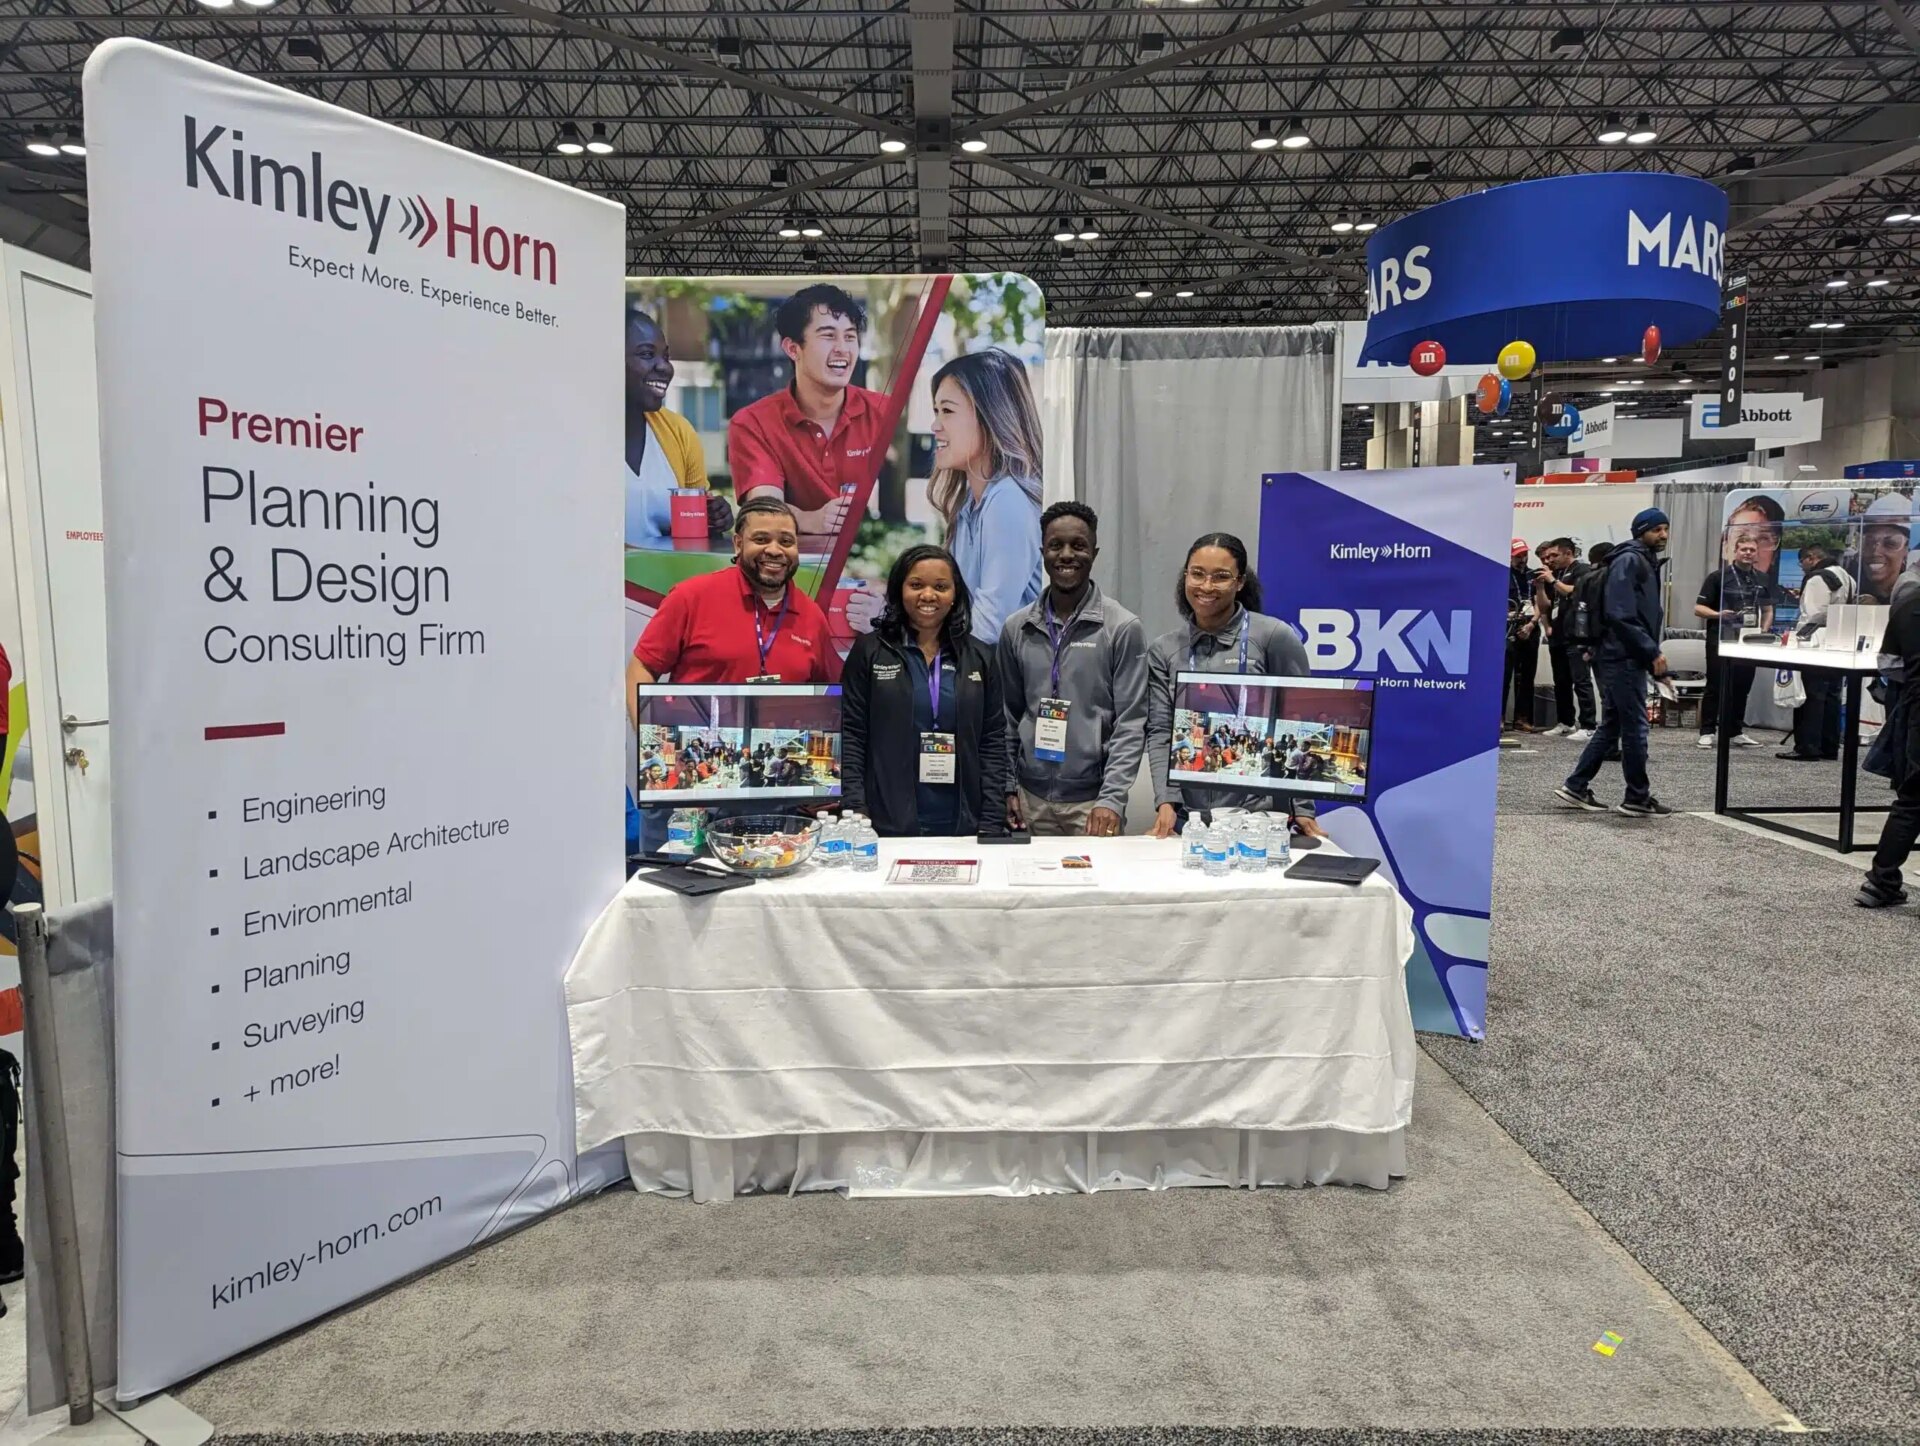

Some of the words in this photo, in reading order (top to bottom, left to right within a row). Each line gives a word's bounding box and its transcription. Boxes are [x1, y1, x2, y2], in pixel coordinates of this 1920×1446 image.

[185, 115, 391, 255] Kimley
[446, 197, 557, 285] Horn
[1627, 209, 1726, 287] MARS
[288, 245, 355, 279] Expect
[362, 264, 414, 294] More.
[421, 278, 510, 316] Experience
[515, 301, 560, 328] Better.
[1367, 245, 1432, 321] ARS
[1420, 352, 1436, 363] m
[198, 396, 364, 453] Premier
[1584, 419, 1608, 436] Abbott
[1740, 408, 1792, 422] Abbott
[203, 466, 439, 548] Planning
[66, 530, 104, 541] EMPLOYEES
[1330, 542, 1380, 562] Kimley
[1393, 543, 1431, 559] Horn
[204, 546, 248, 602] &
[271, 547, 450, 616] Design
[204, 624, 406, 666] Consulting
[420, 623, 485, 656] Firm
[1299, 608, 1473, 676] BKN
[1414, 678, 1467, 690] Network
[243, 785, 387, 823] Engineering
[244, 839, 380, 880] Landscape
[387, 818, 510, 854] Architecture
[244, 881, 413, 936] Environmental
[244, 951, 351, 993] Planning
[243, 1000, 365, 1048] Surveying
[244, 1085, 260, 1102] +
[270, 1053, 341, 1096] more!
[212, 1195, 442, 1309] kimley-horn.com
